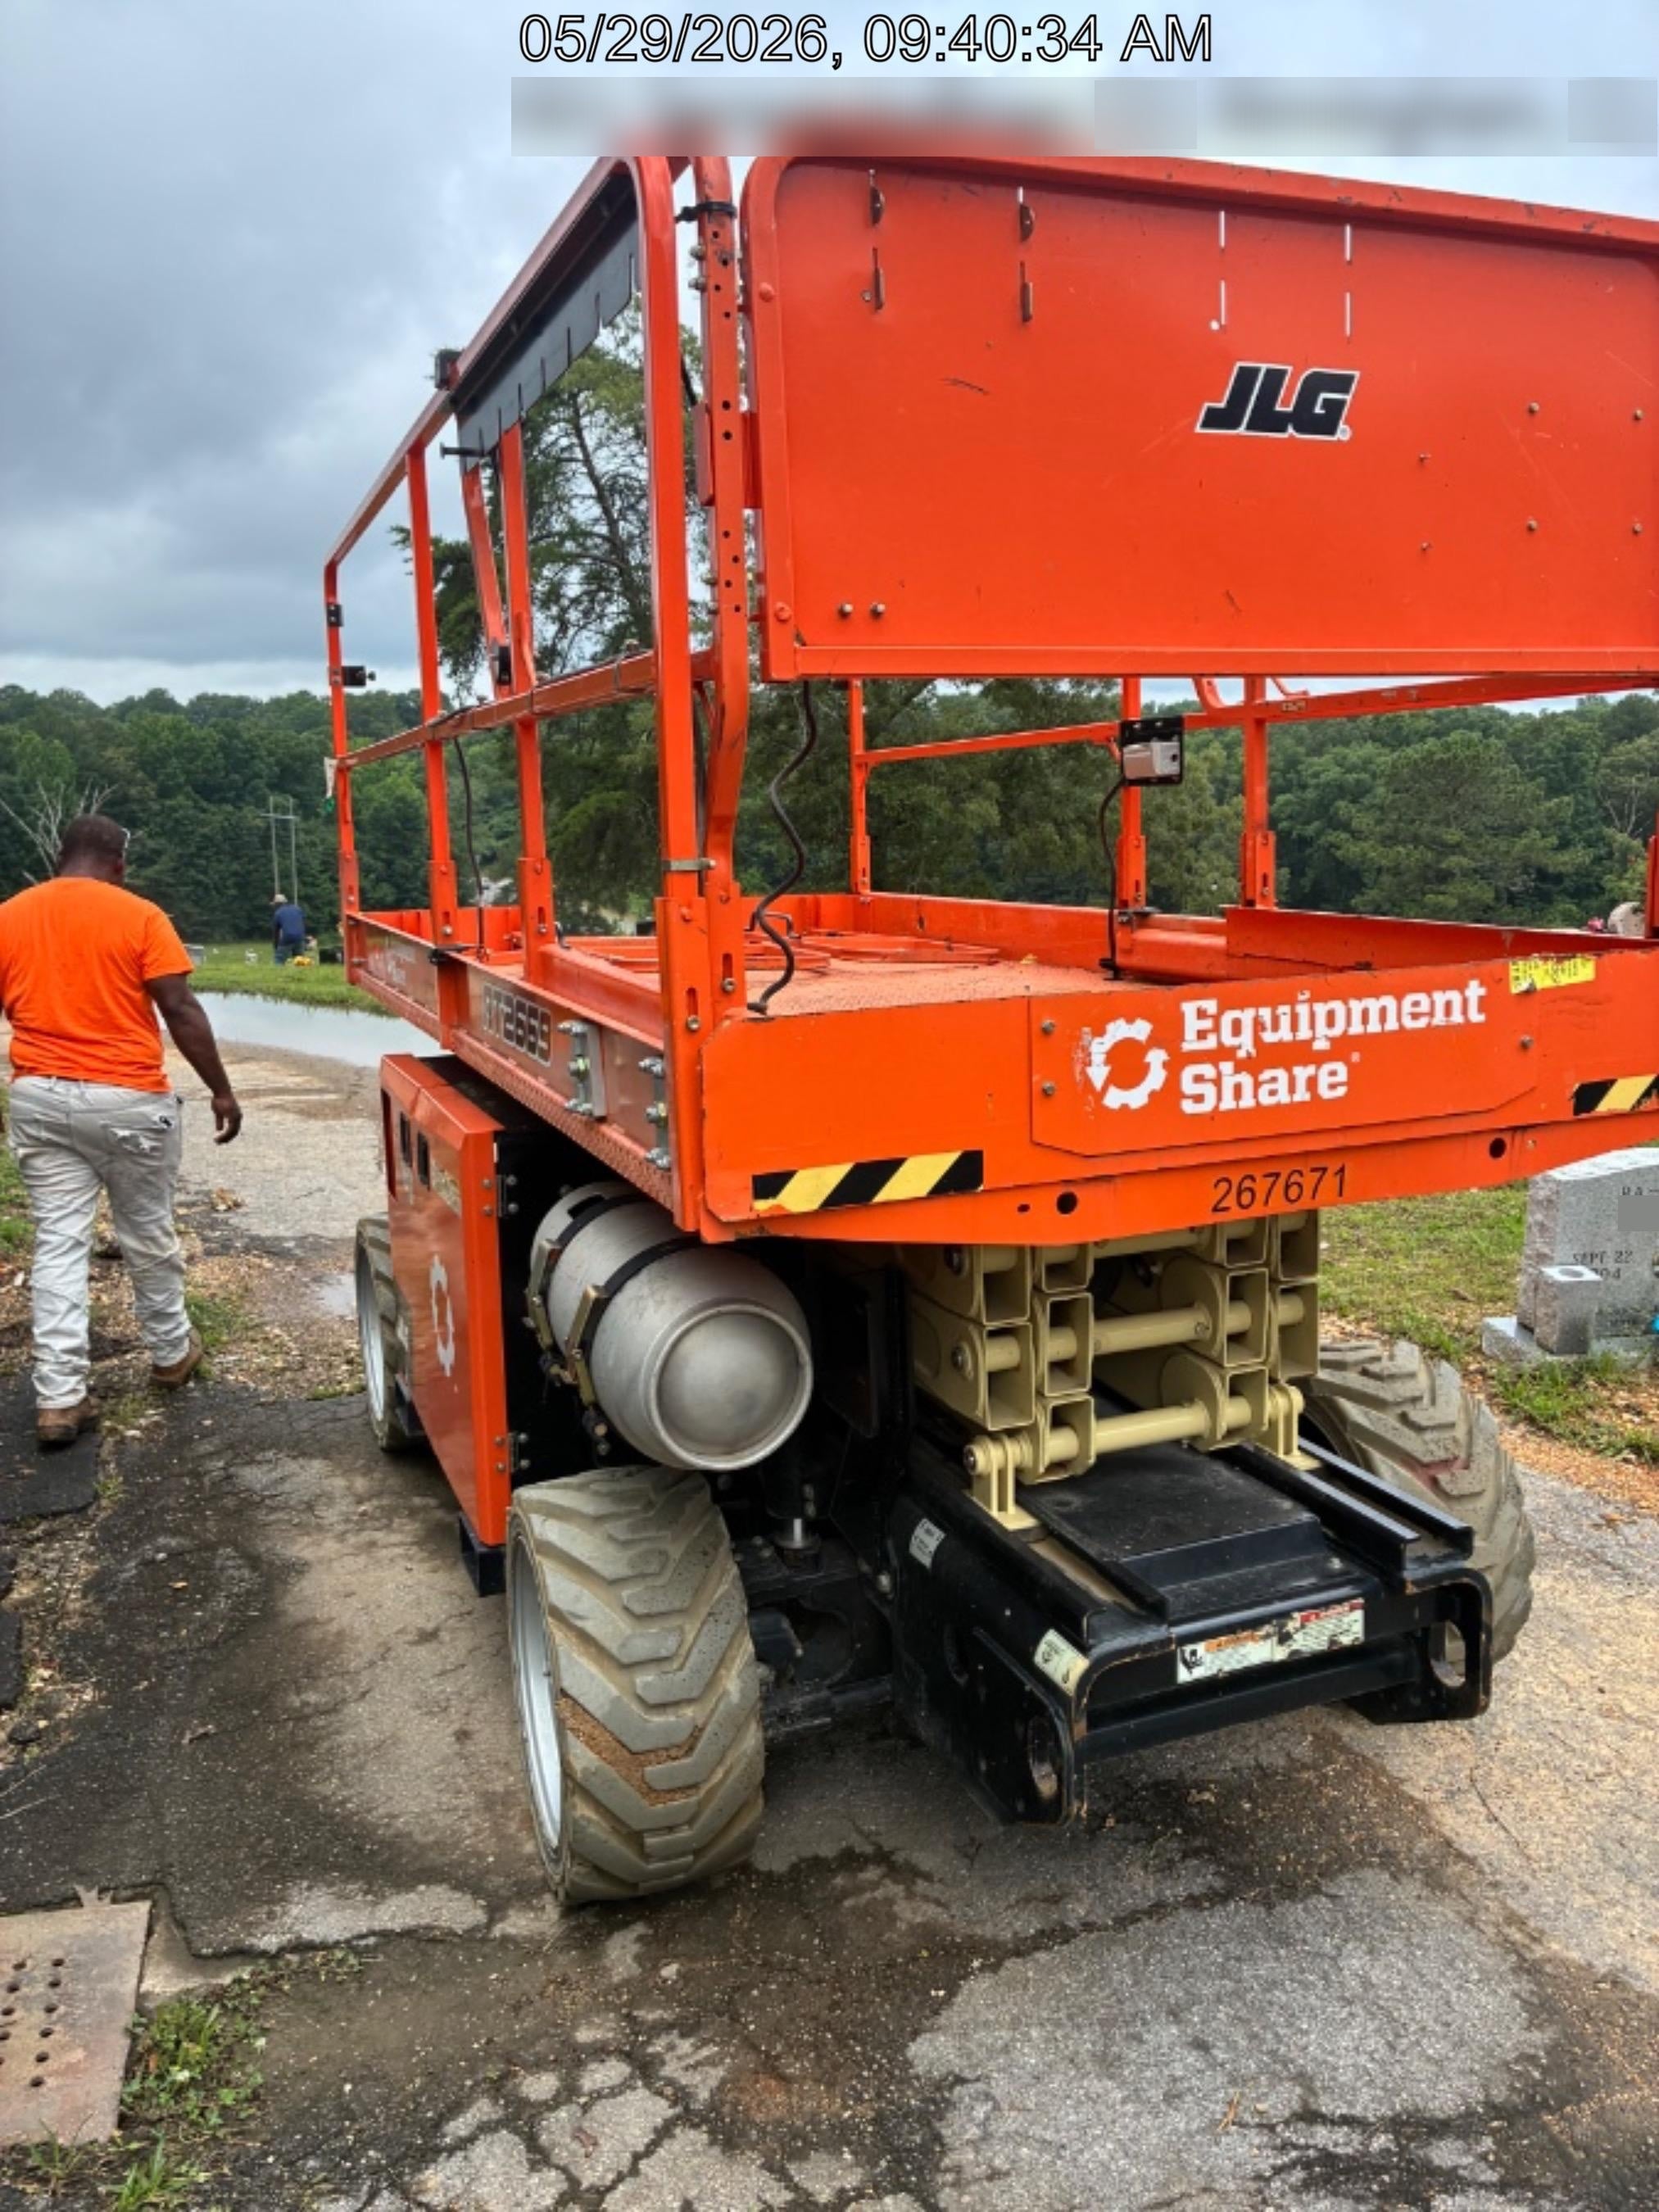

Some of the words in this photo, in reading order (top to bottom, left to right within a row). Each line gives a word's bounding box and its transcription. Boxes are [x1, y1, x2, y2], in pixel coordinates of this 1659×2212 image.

[1194, 361, 1360, 440] JLG
[1181, 979, 1486, 1057] Equipment
[1181, 1060, 1349, 1115] Share
[1211, 1163, 1346, 1213] 267671
